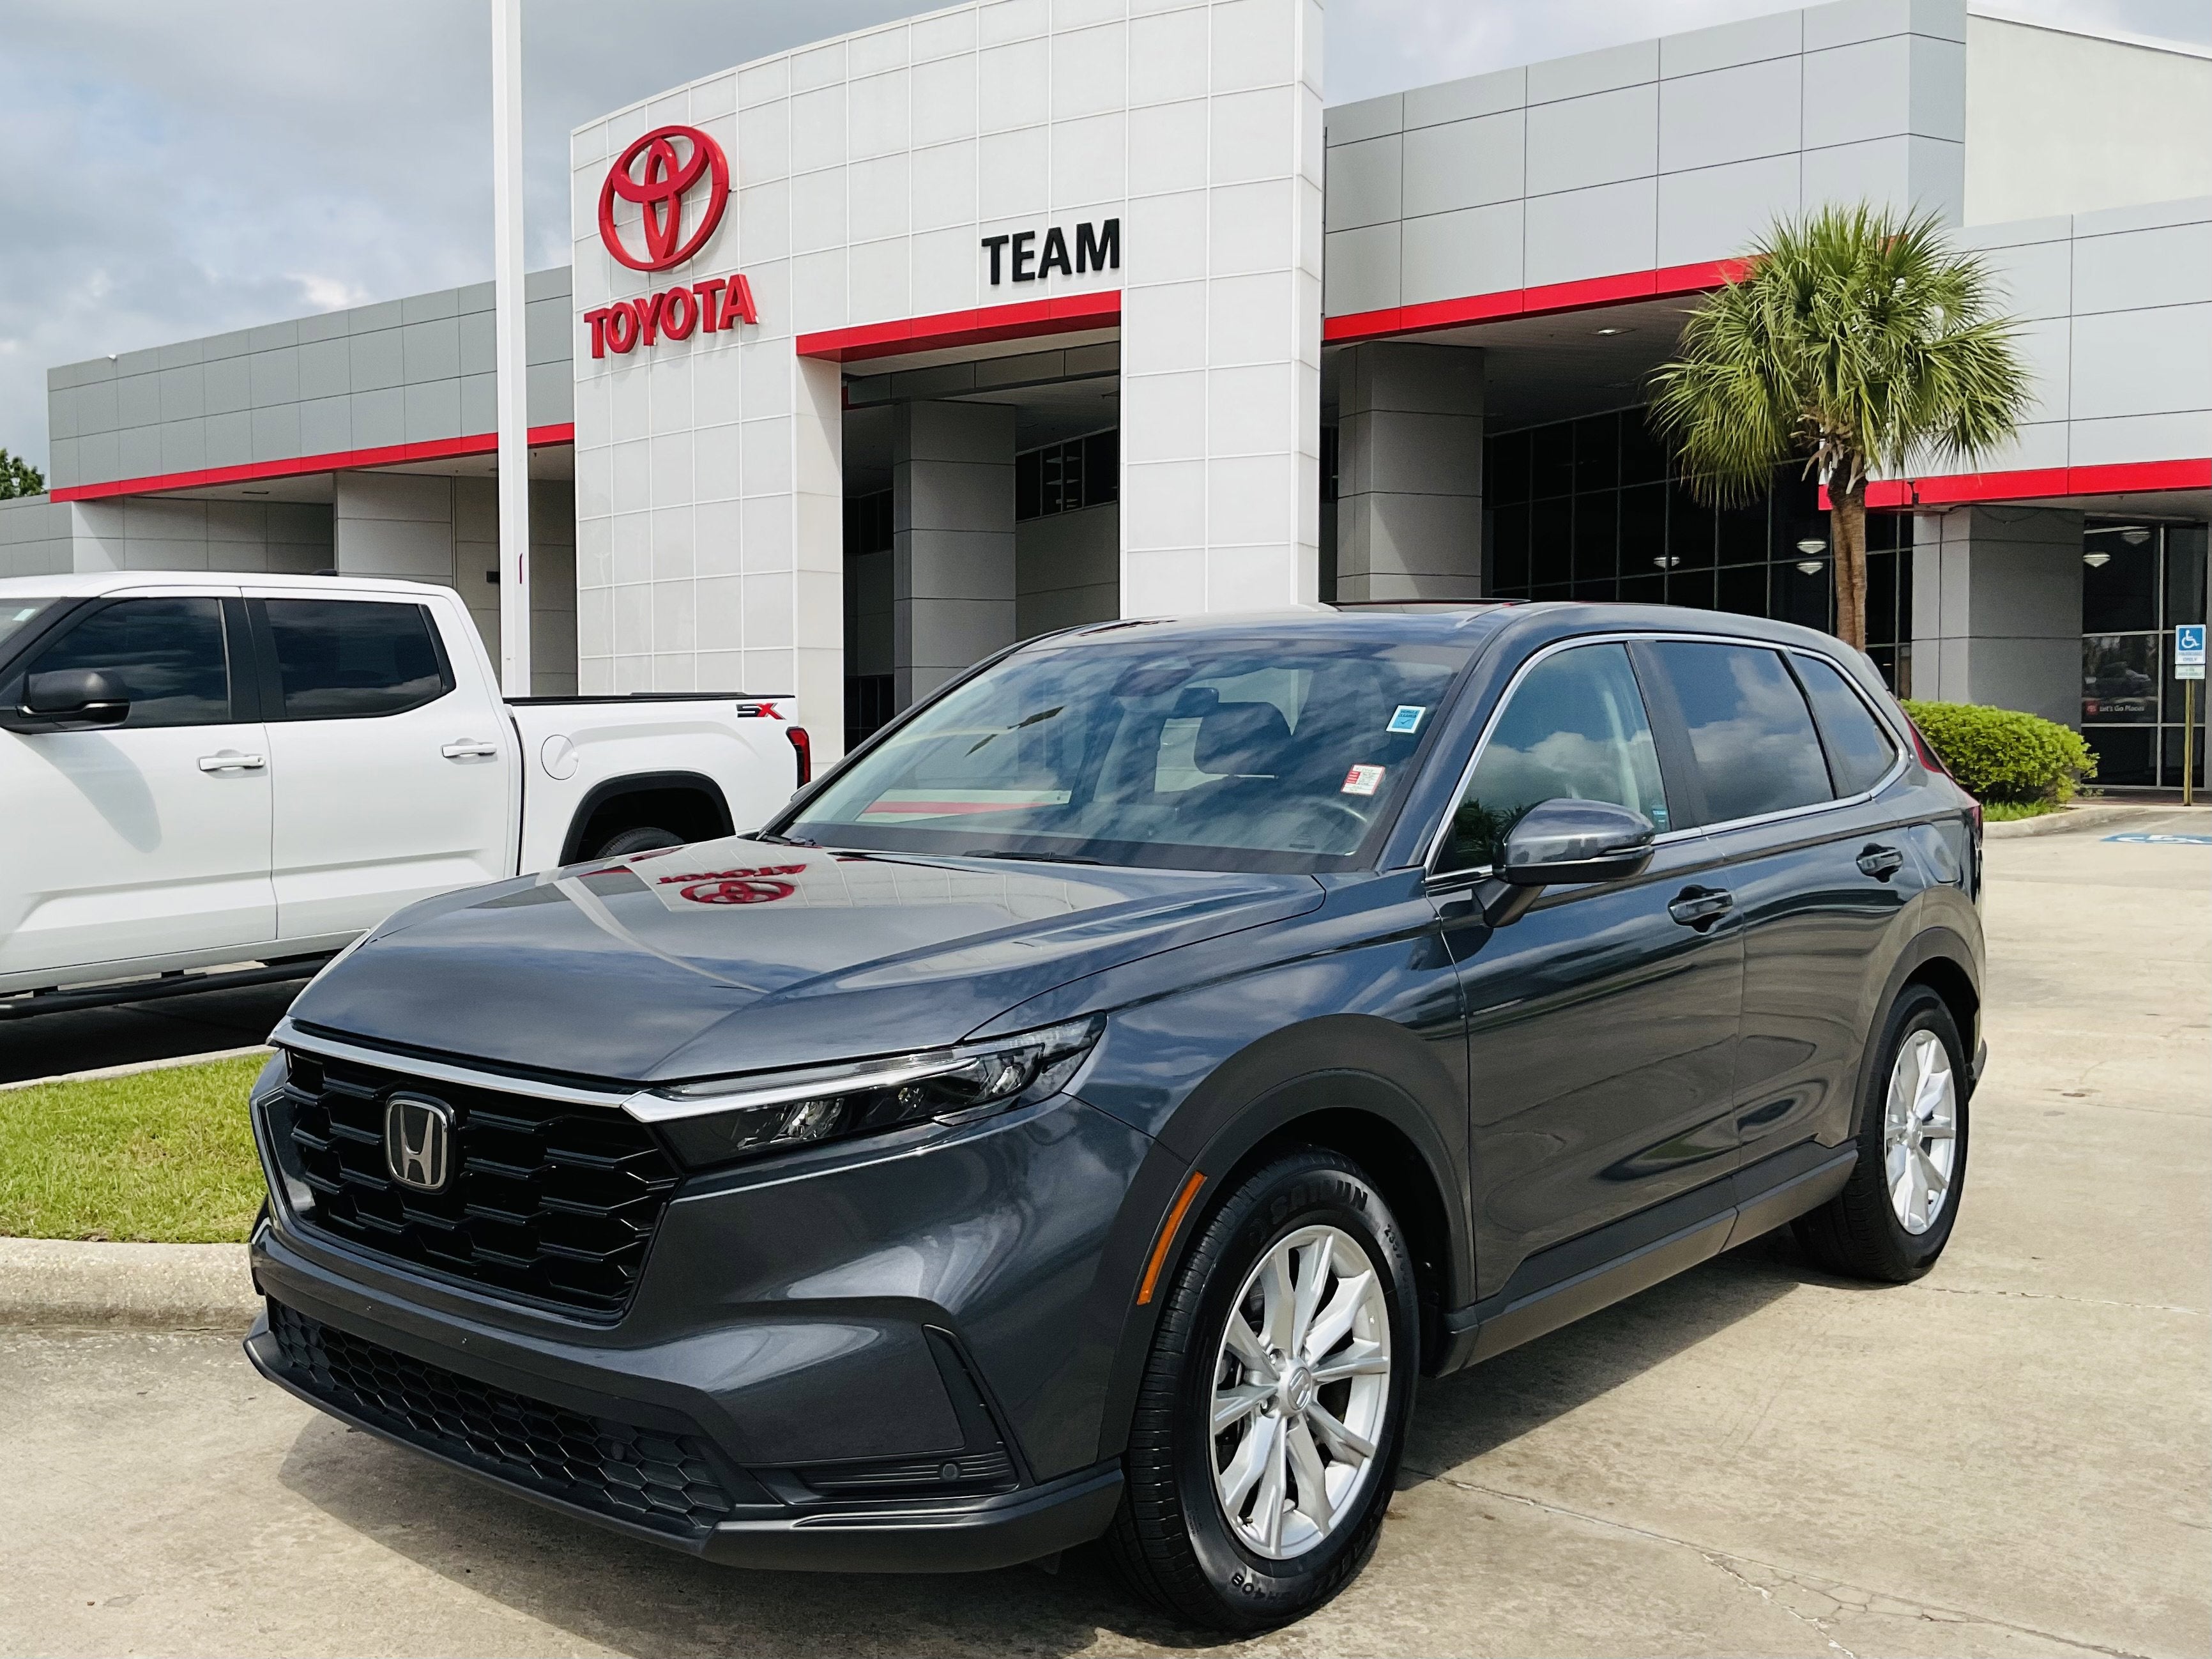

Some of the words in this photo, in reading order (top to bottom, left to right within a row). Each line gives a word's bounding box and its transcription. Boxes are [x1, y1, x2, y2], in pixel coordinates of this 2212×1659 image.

[981, 217, 1120, 285] TEAM
[584, 273, 759, 359] TOYOTA
[736, 703, 786, 720] SX
